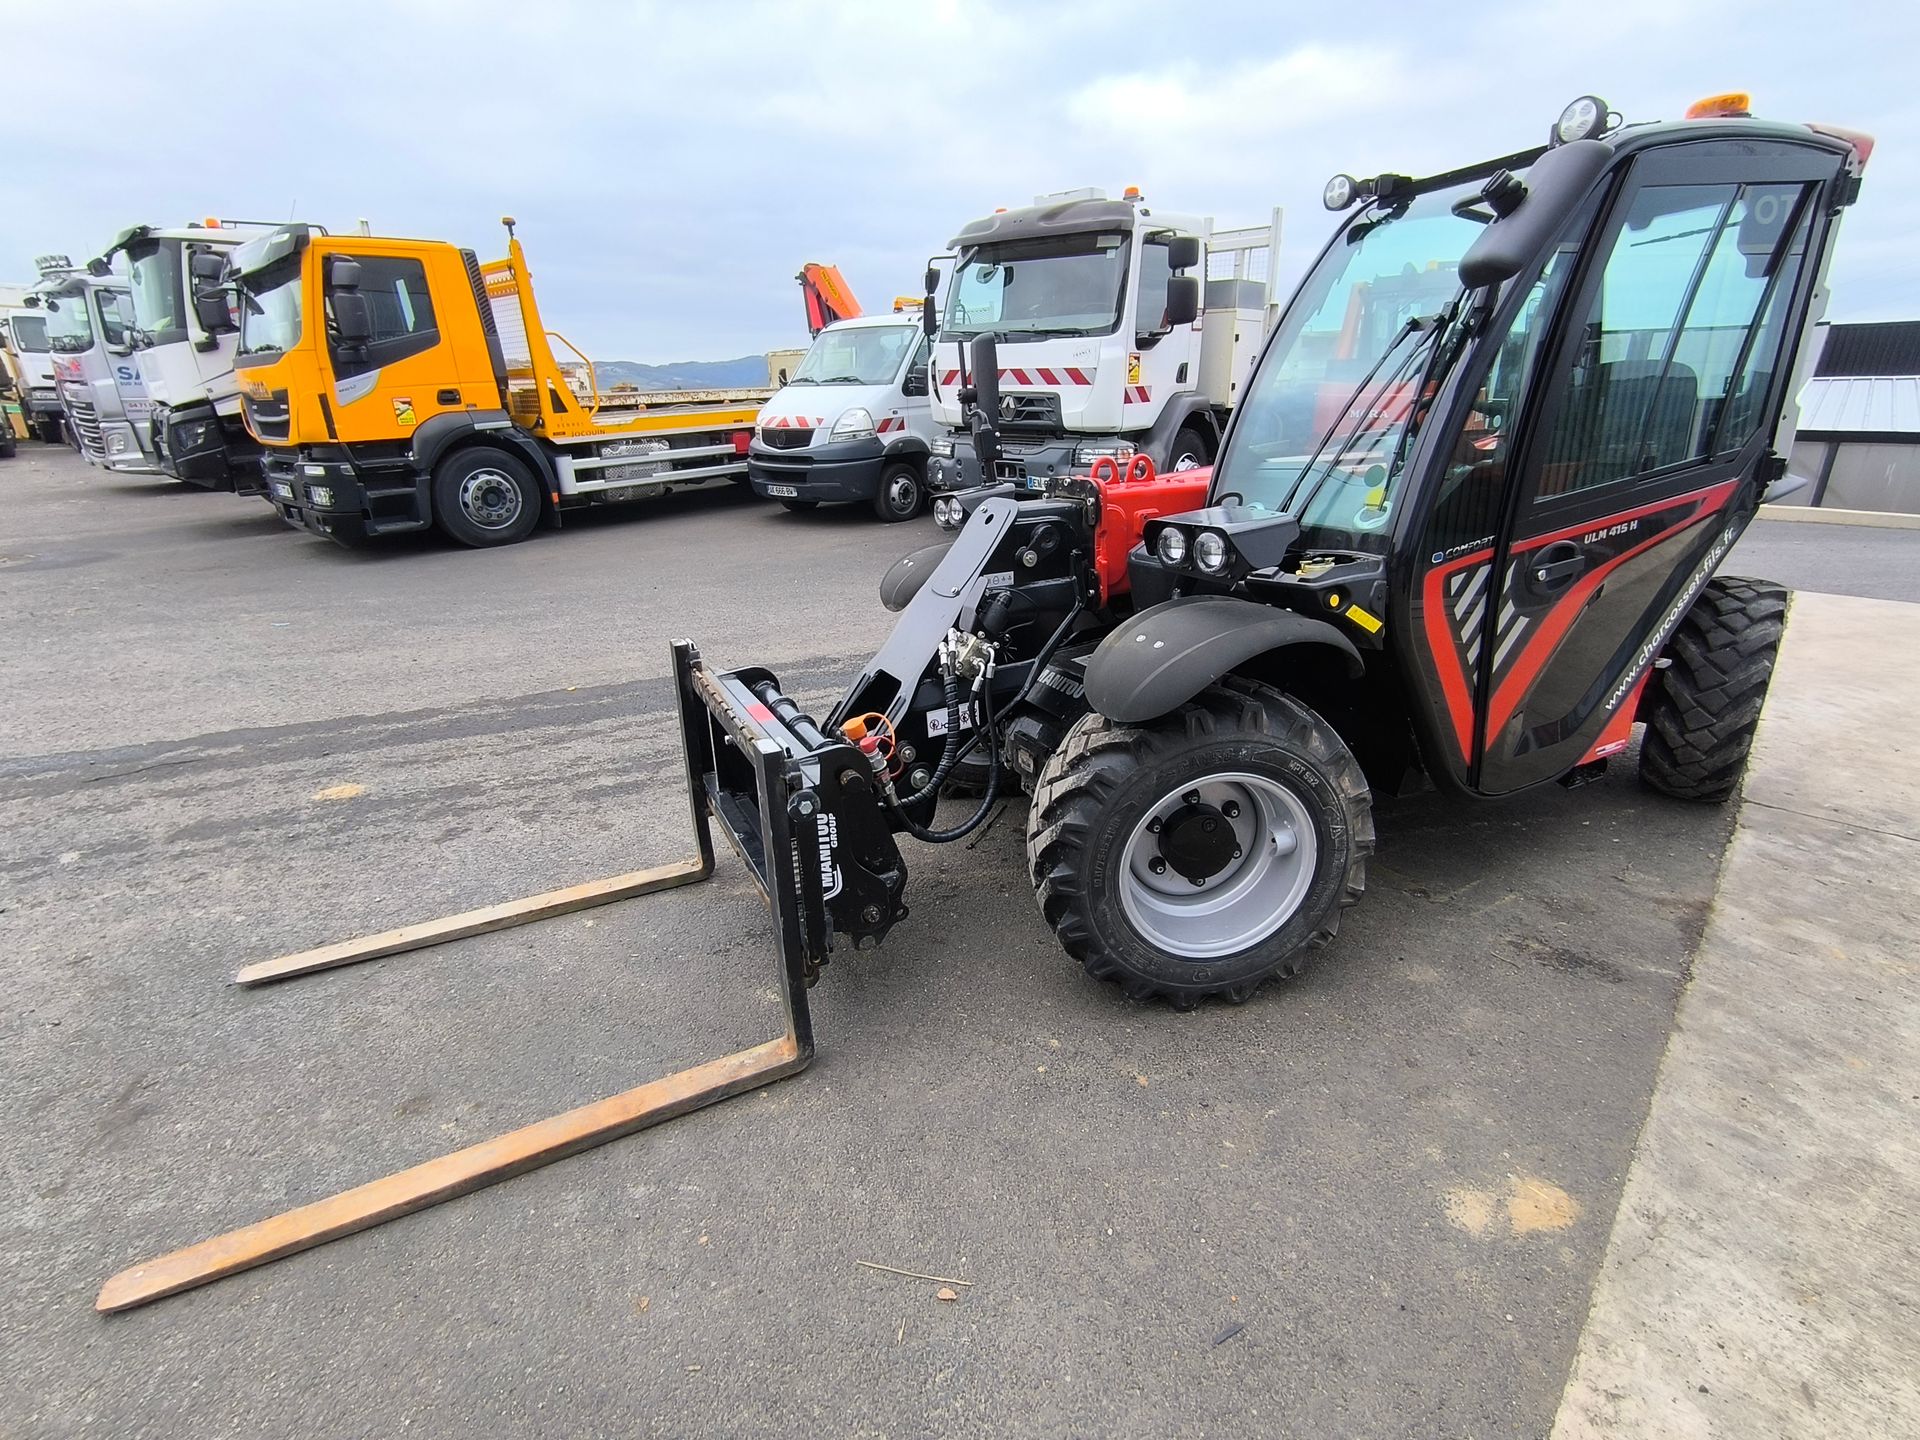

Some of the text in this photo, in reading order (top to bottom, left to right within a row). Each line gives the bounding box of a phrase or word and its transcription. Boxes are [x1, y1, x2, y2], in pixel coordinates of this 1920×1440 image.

[1350, 409, 1388, 418] MRA
[1584, 520, 1638, 544] ULM 415 H
[1445, 535, 1496, 559] COMFORT
[1605, 527, 1734, 710] www.charcosset-fils.fr
[828, 812, 838, 848] GROUP
